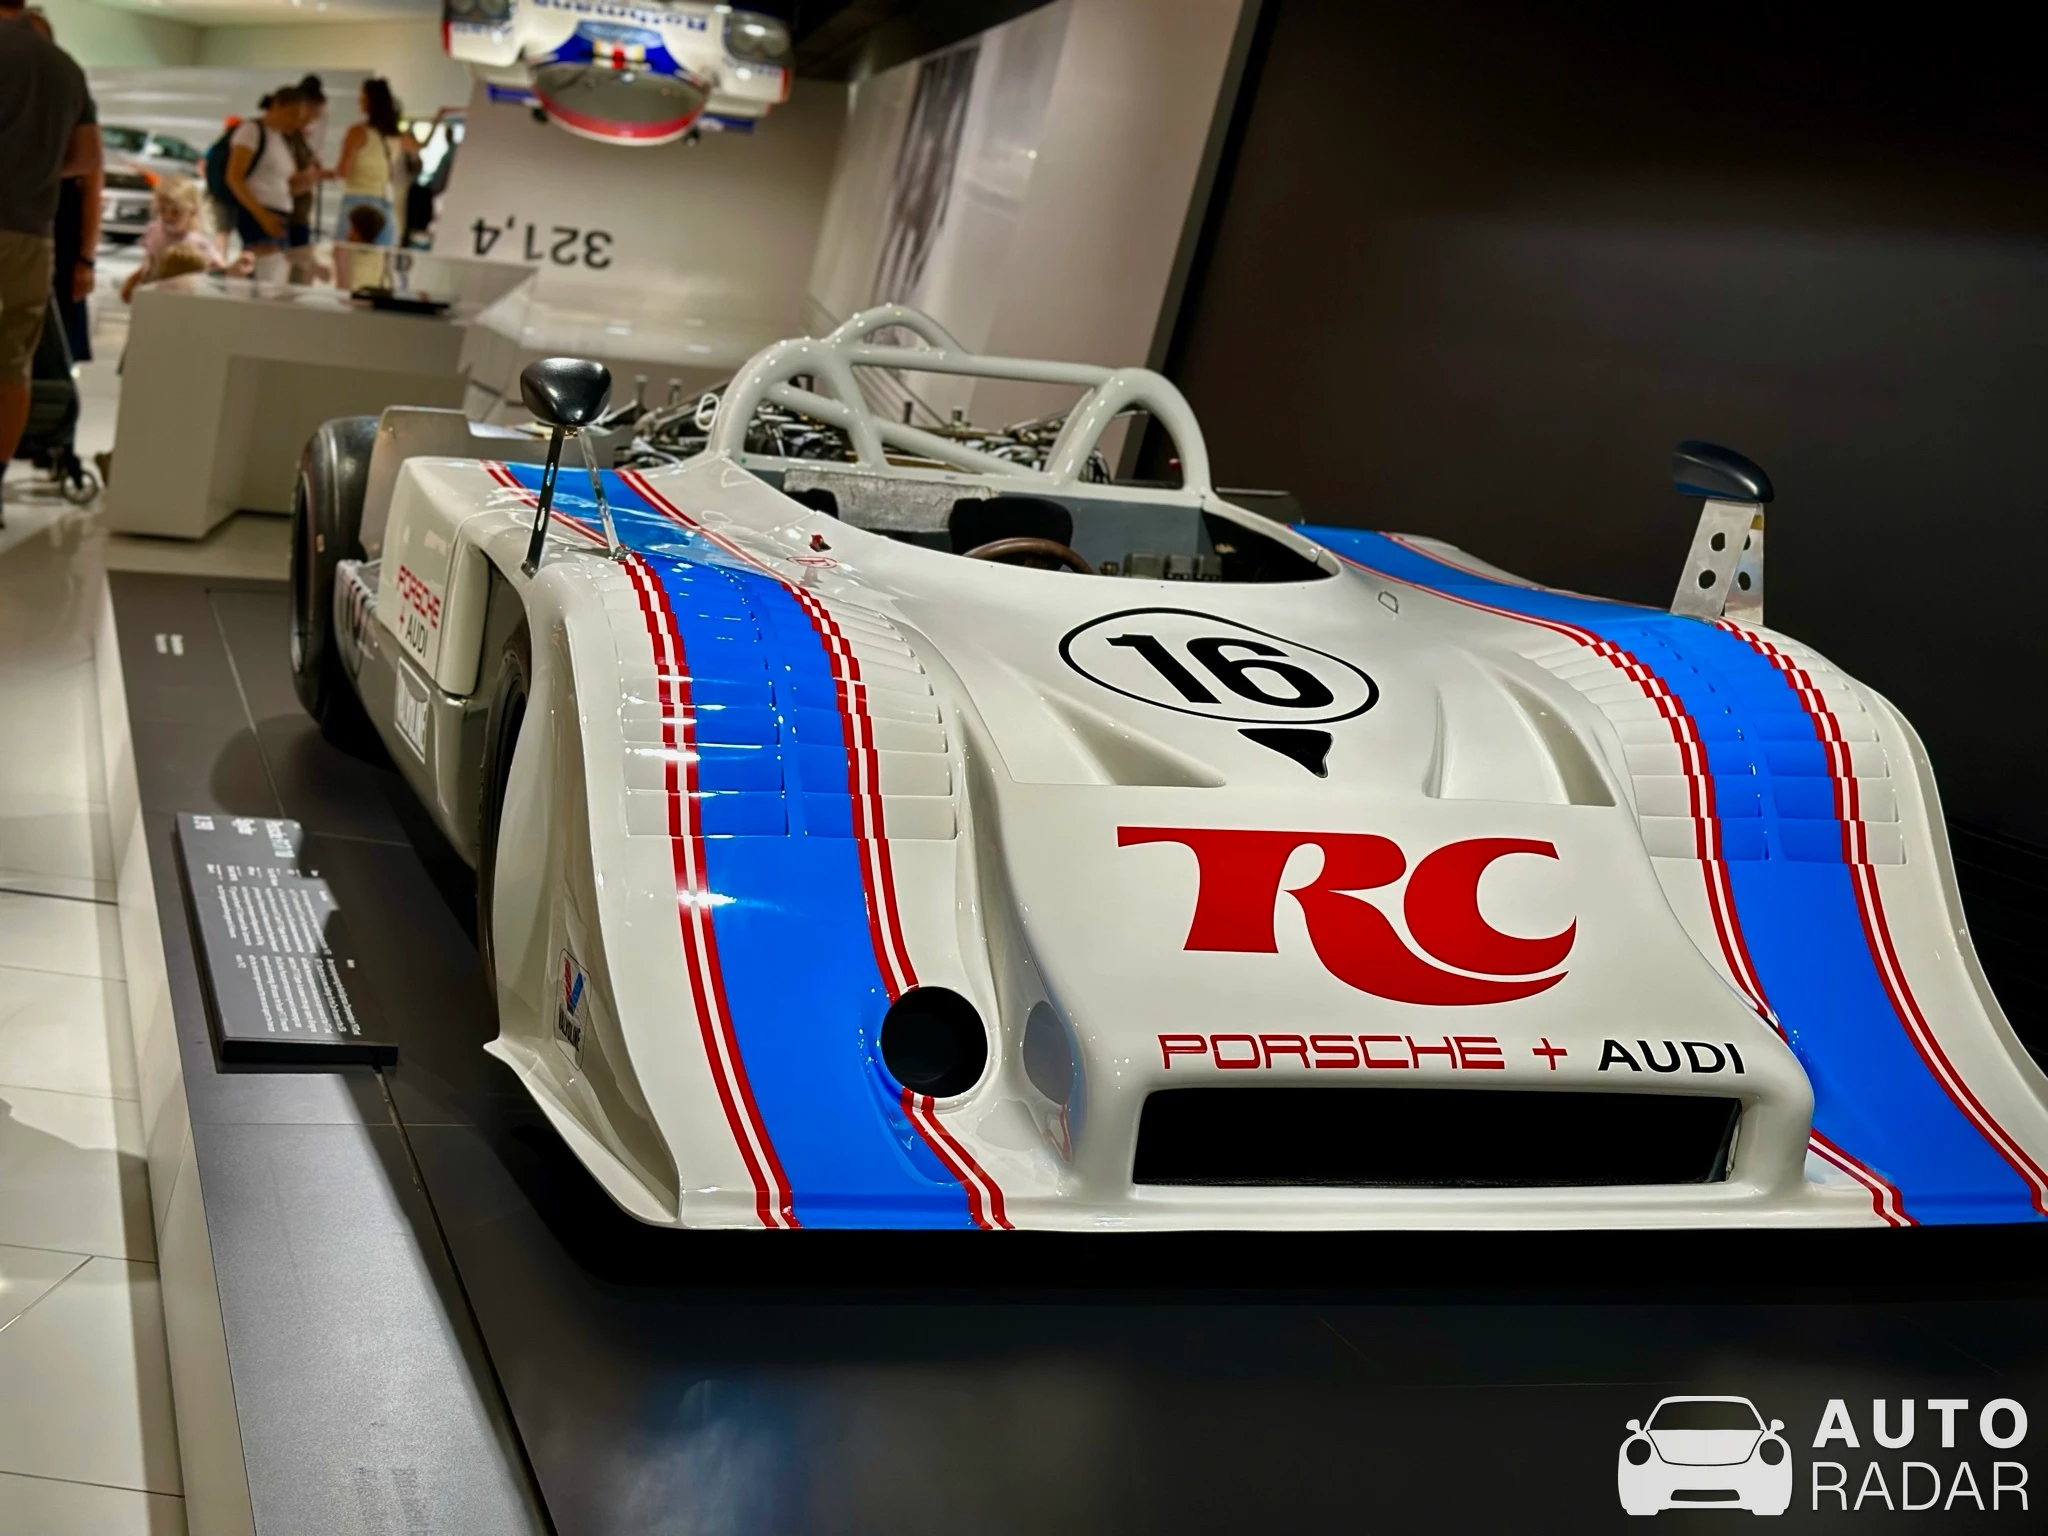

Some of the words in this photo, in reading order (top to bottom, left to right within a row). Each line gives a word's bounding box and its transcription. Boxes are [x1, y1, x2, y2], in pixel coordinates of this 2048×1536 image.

[471, 214, 613, 270] 321,4
[397, 564, 441, 629] PORSCHE
[405, 613, 429, 658] AUDI
[1105, 633, 1335, 709] 16
[1117, 826, 1577, 1007] RC
[1158, 1034, 1505, 1070] PORSCHE
[1533, 1037, 1568, 1070] +
[1598, 1039, 1745, 1074] AUDI
